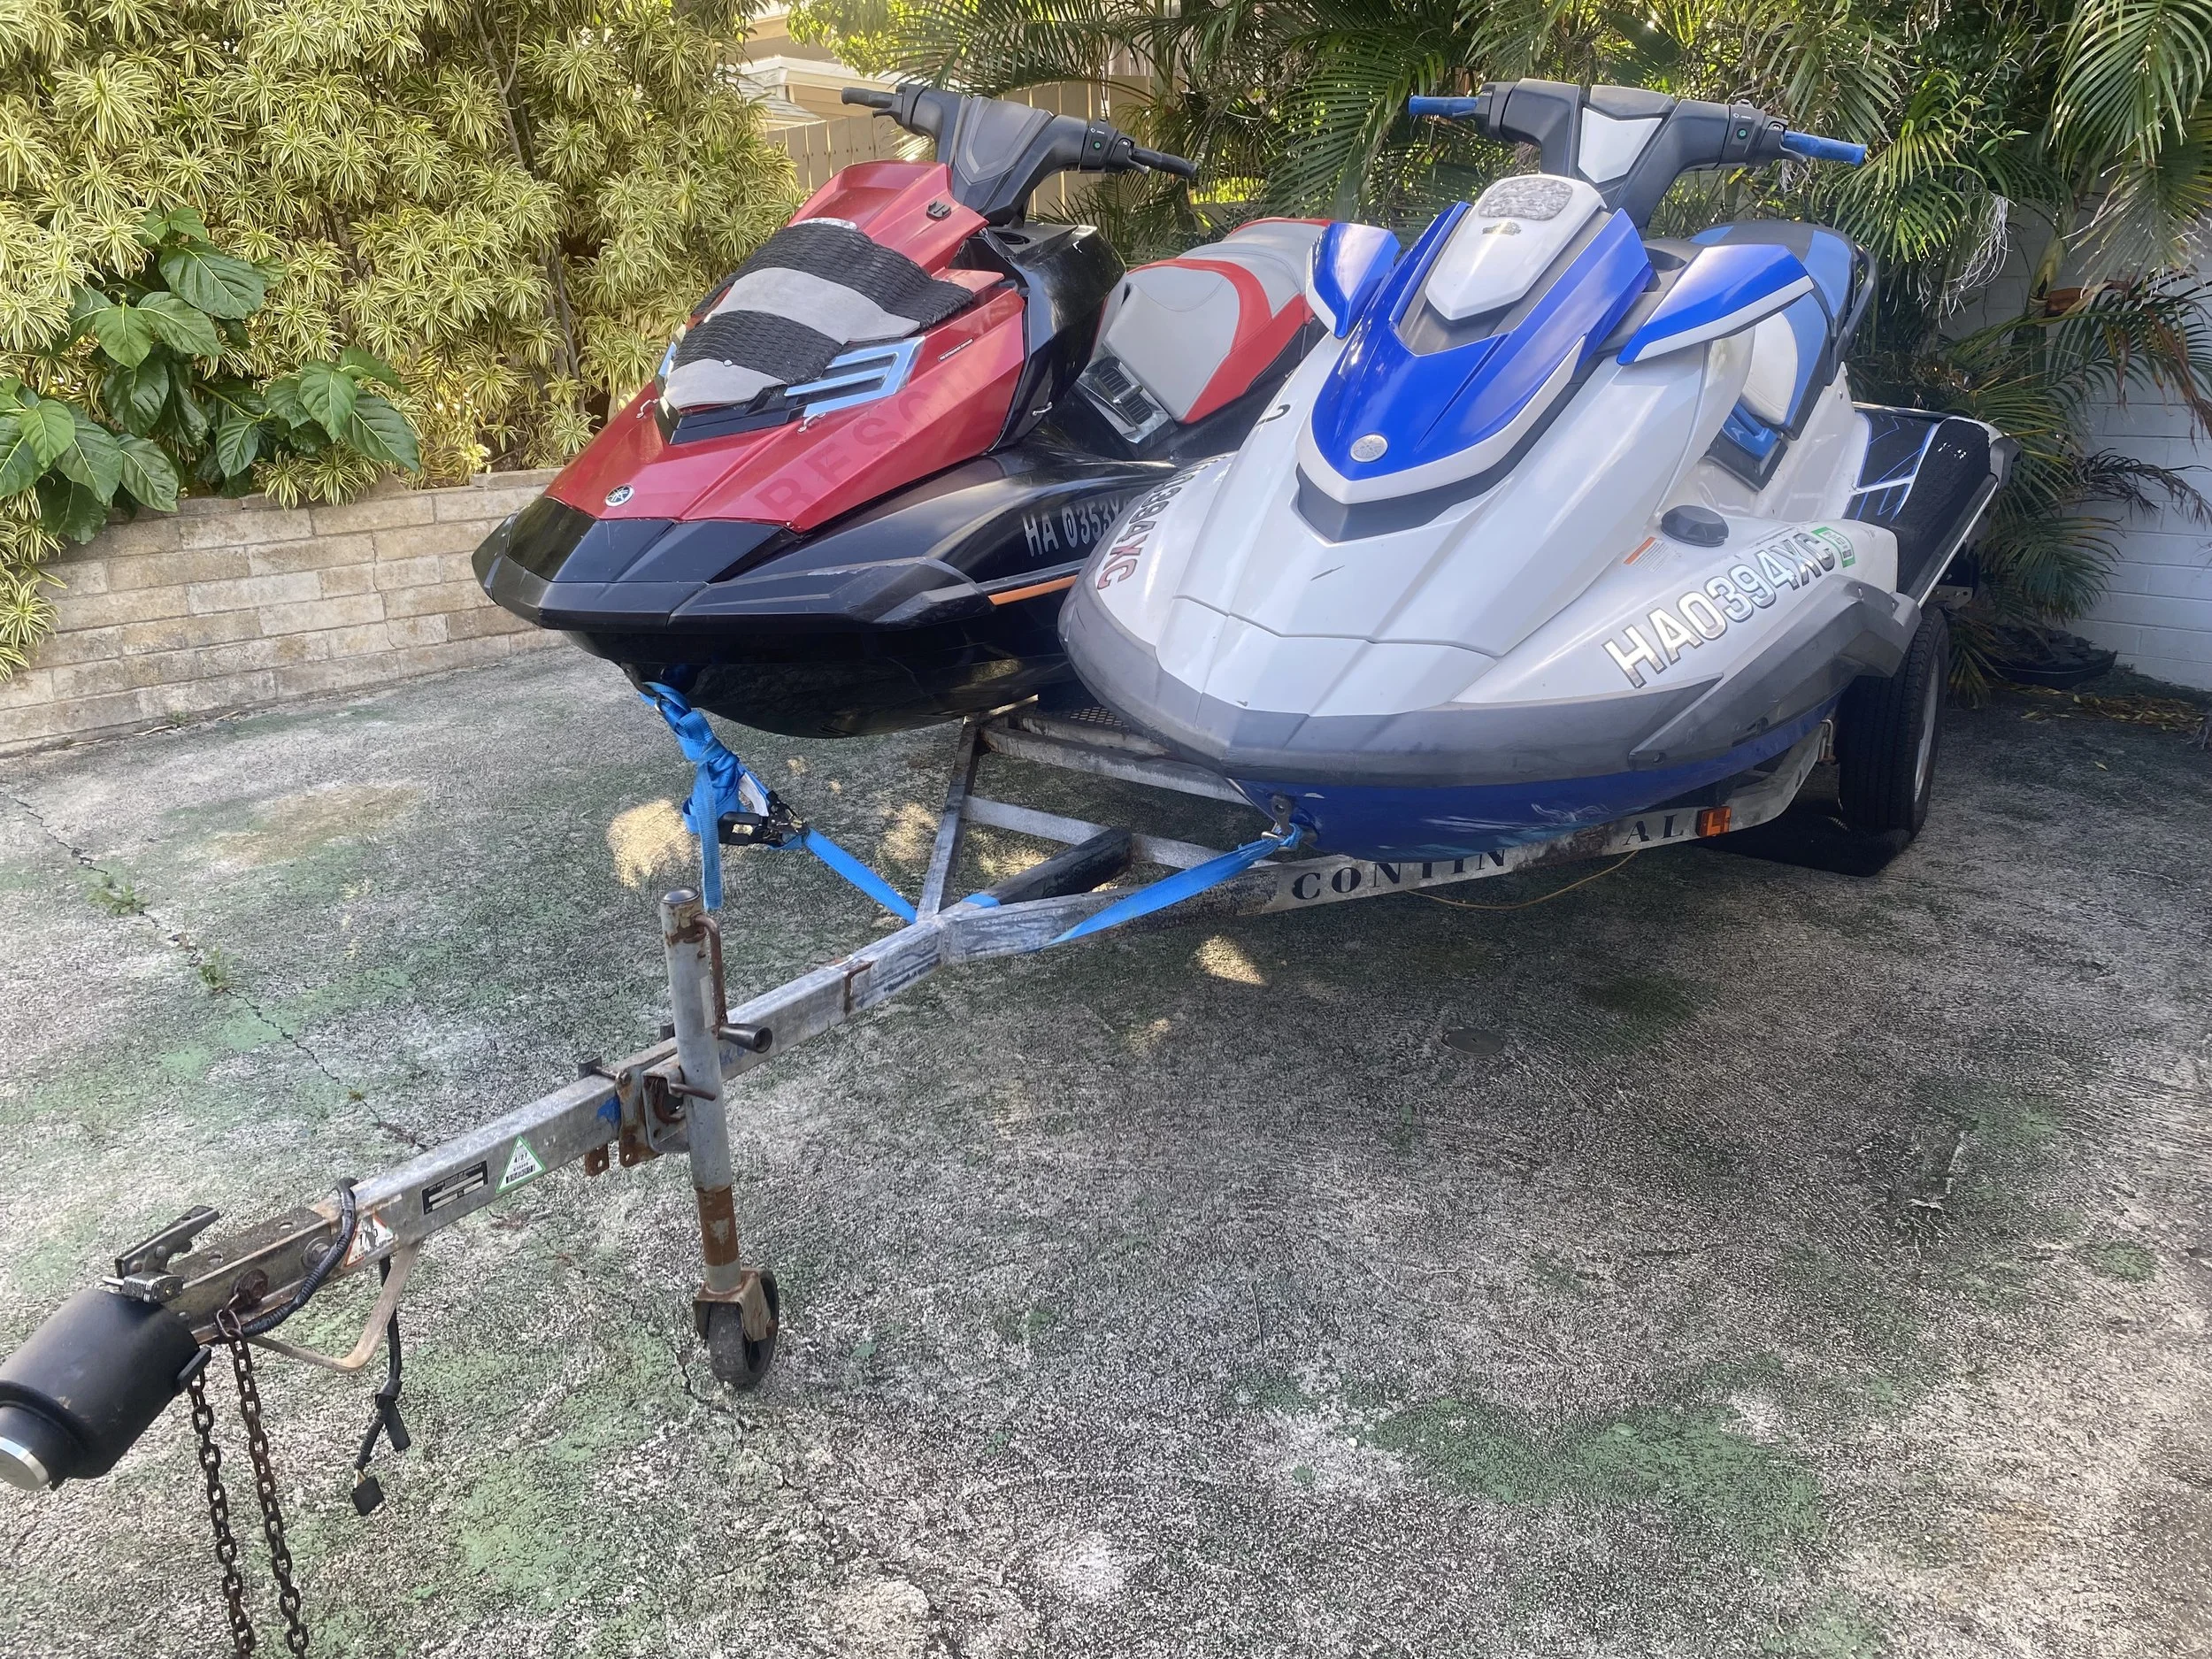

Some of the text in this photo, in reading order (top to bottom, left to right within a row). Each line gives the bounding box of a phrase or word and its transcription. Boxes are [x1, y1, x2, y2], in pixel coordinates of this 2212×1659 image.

[1021, 511, 1060, 558] HA
[1601, 533, 1836, 688] HA0394XC
[1292, 813, 1685, 901] CONTINAL
